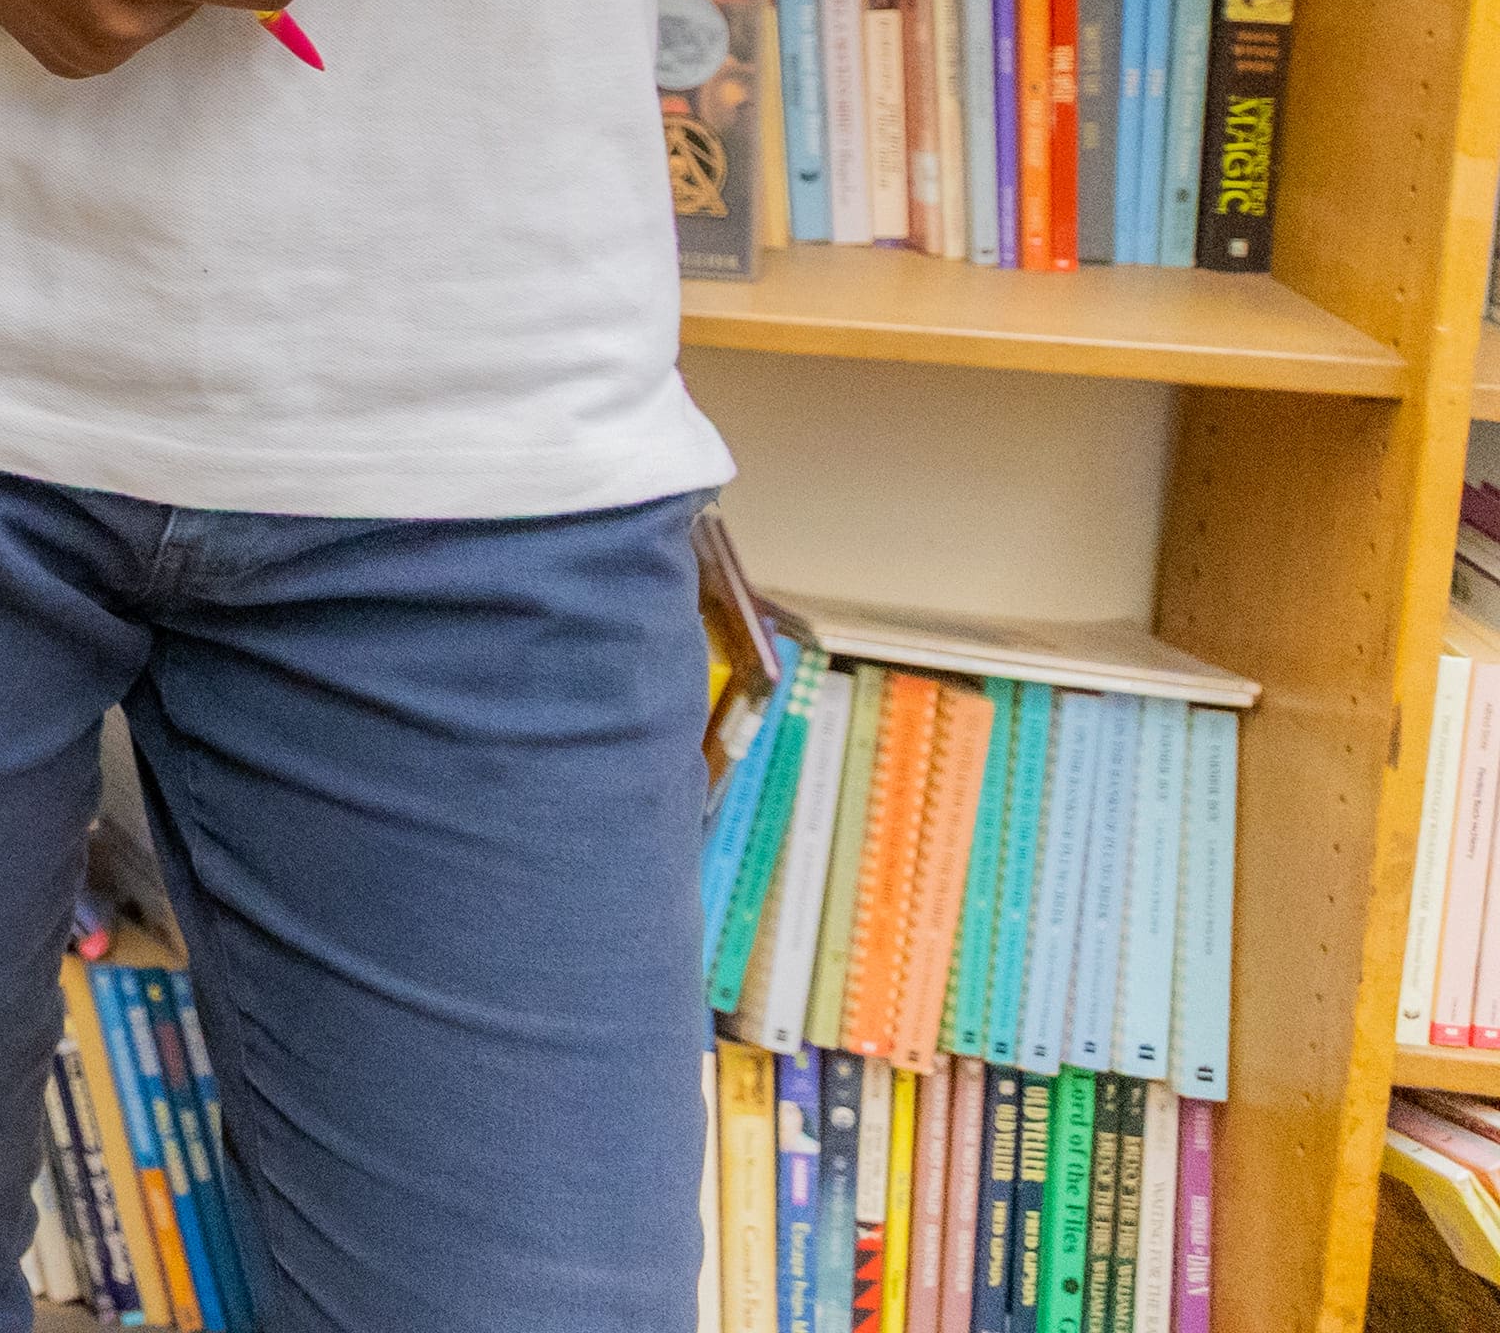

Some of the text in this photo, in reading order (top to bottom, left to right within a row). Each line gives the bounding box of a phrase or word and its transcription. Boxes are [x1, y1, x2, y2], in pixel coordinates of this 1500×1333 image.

[1216, 95, 1252, 215] MAGIC
[1064, 1134, 1089, 1161] of
[1065, 1167, 1090, 1199] the
[1062, 1204, 1088, 1256] Flies
